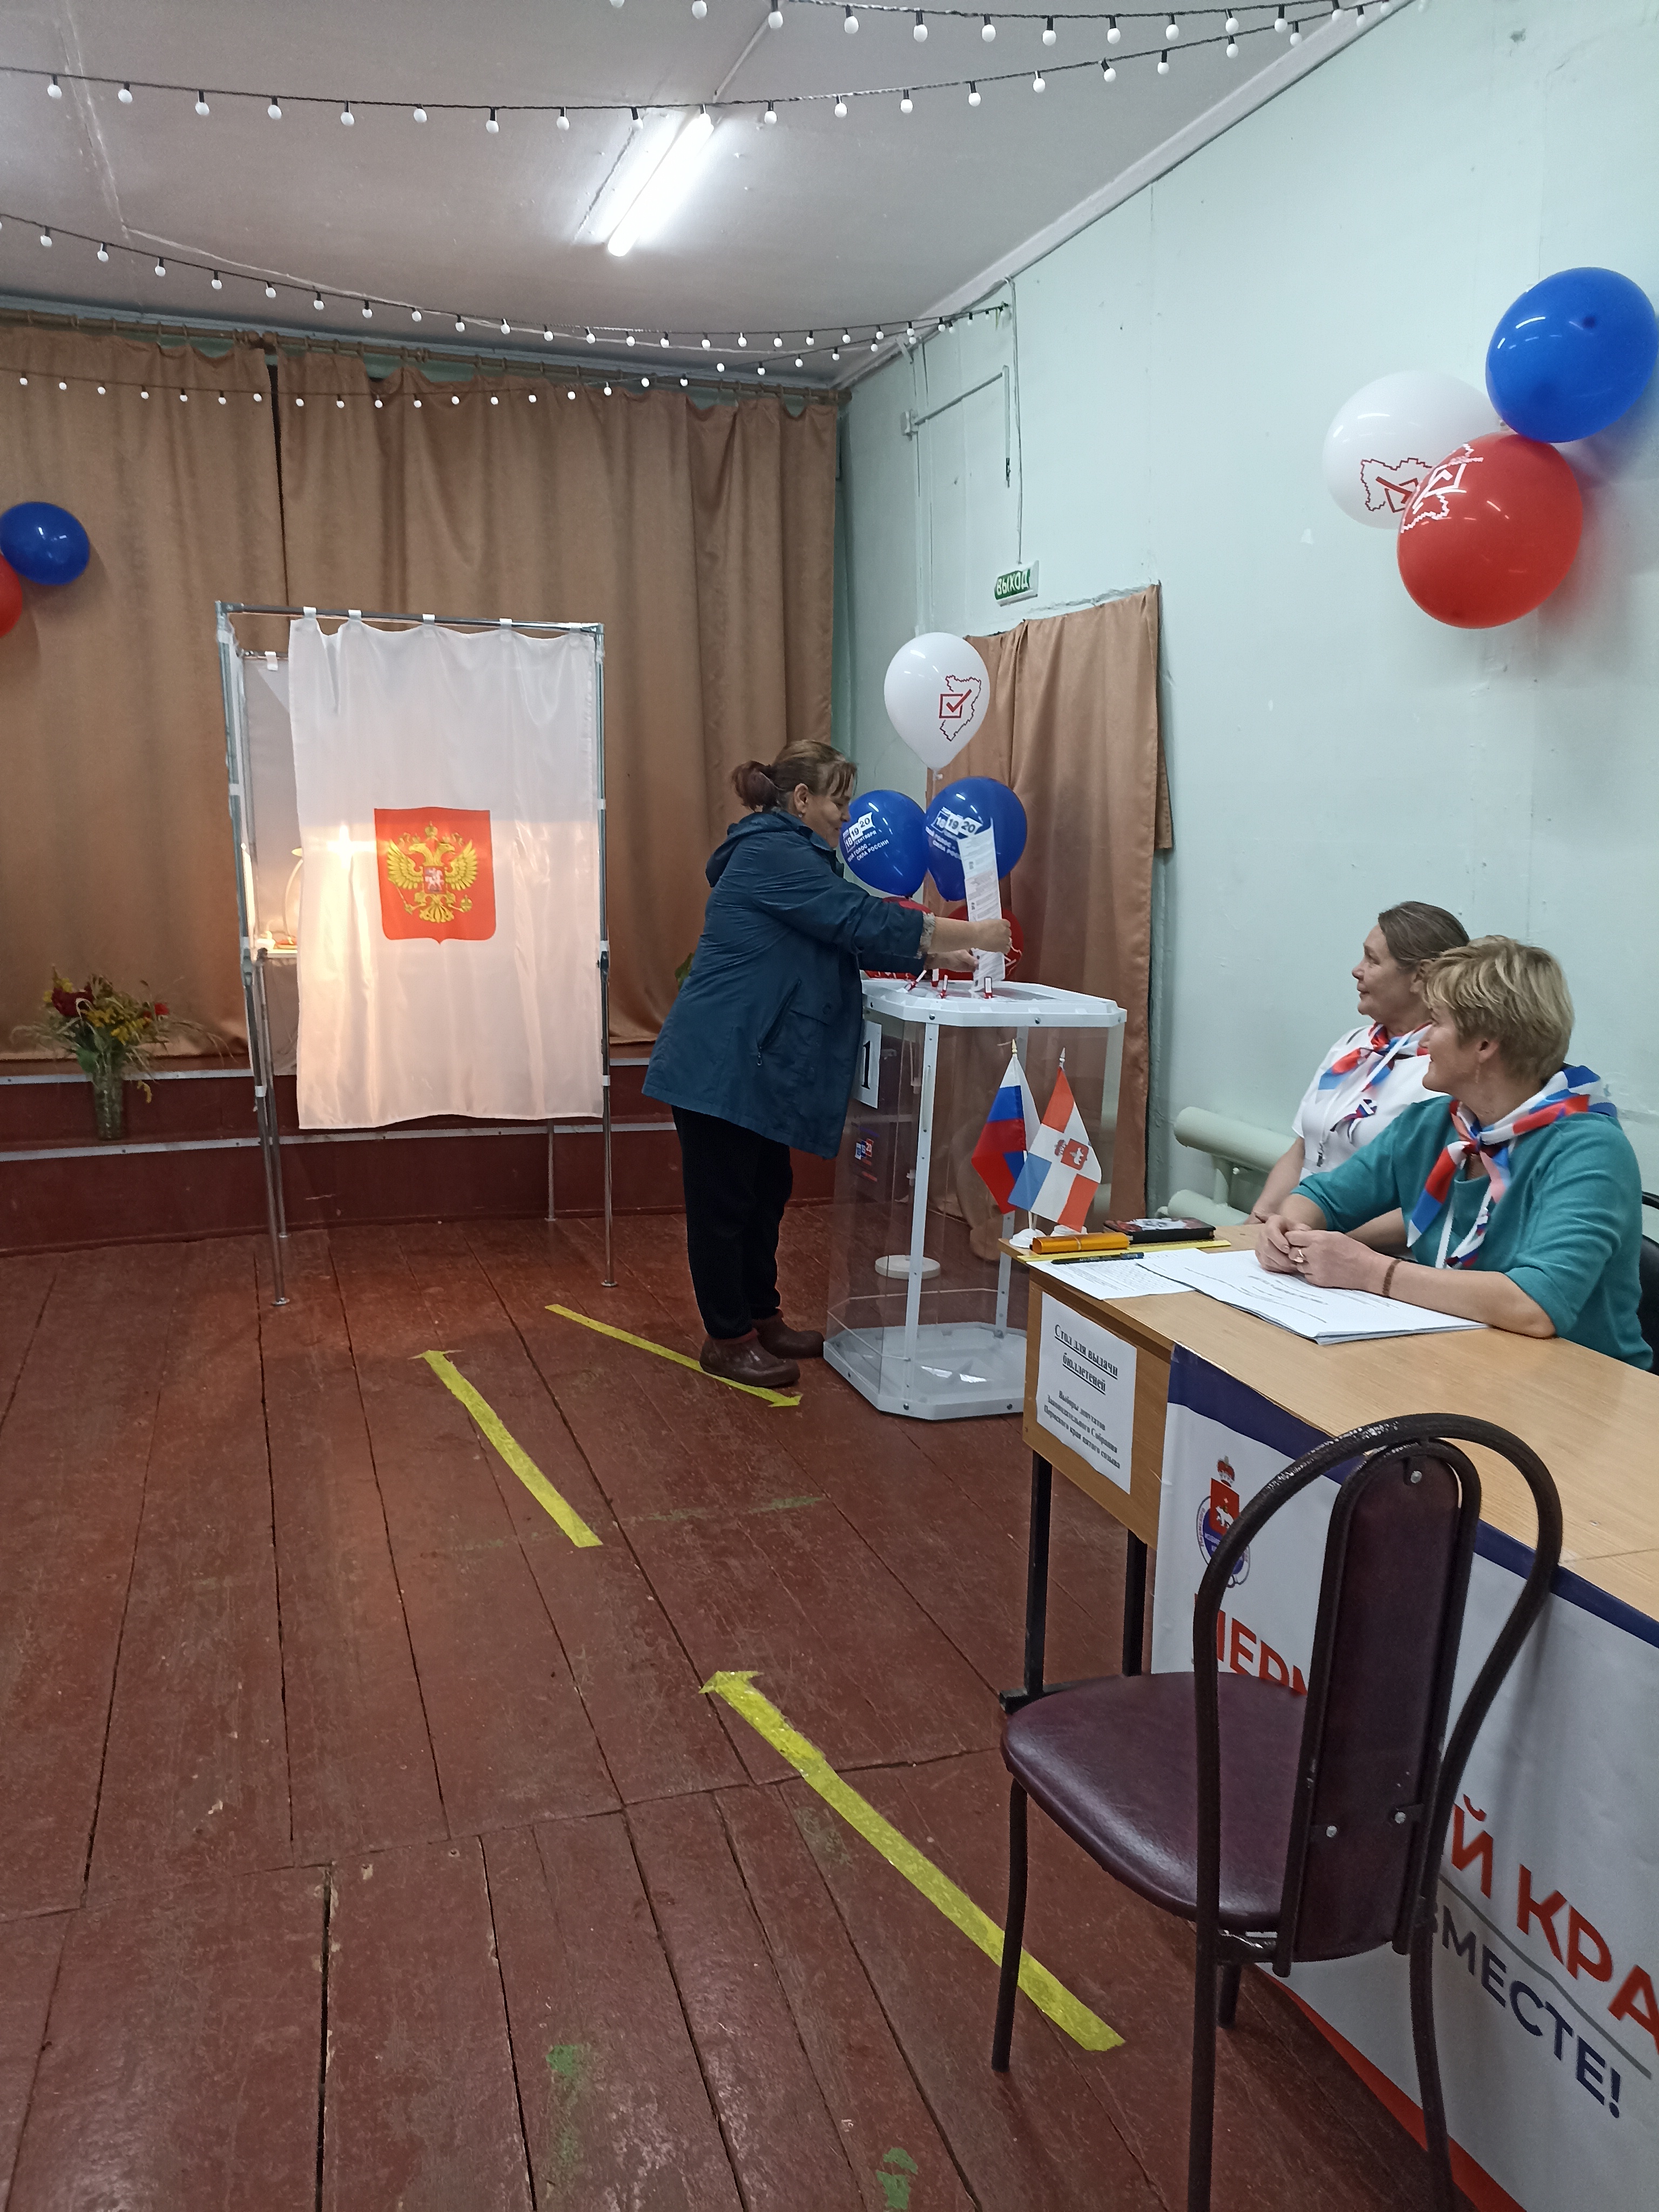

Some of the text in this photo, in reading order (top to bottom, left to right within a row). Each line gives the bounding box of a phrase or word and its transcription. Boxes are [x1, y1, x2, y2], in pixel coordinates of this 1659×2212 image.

[996, 570, 1028, 595] ВЫХОД
[846, 837, 853, 847] 18
[851, 827, 859, 837] 19
[860, 818, 870, 827] 20
[948, 819, 959, 830] 19
[961, 821, 975, 833] 20
[867, 839, 889, 853] РОССИИ
[1055, 1324, 1118, 1377] Стол для выдачи
[1063, 1352, 1106, 1392] бюллетеней
[1434, 1903, 1621, 2119] МЕСТЕ!
